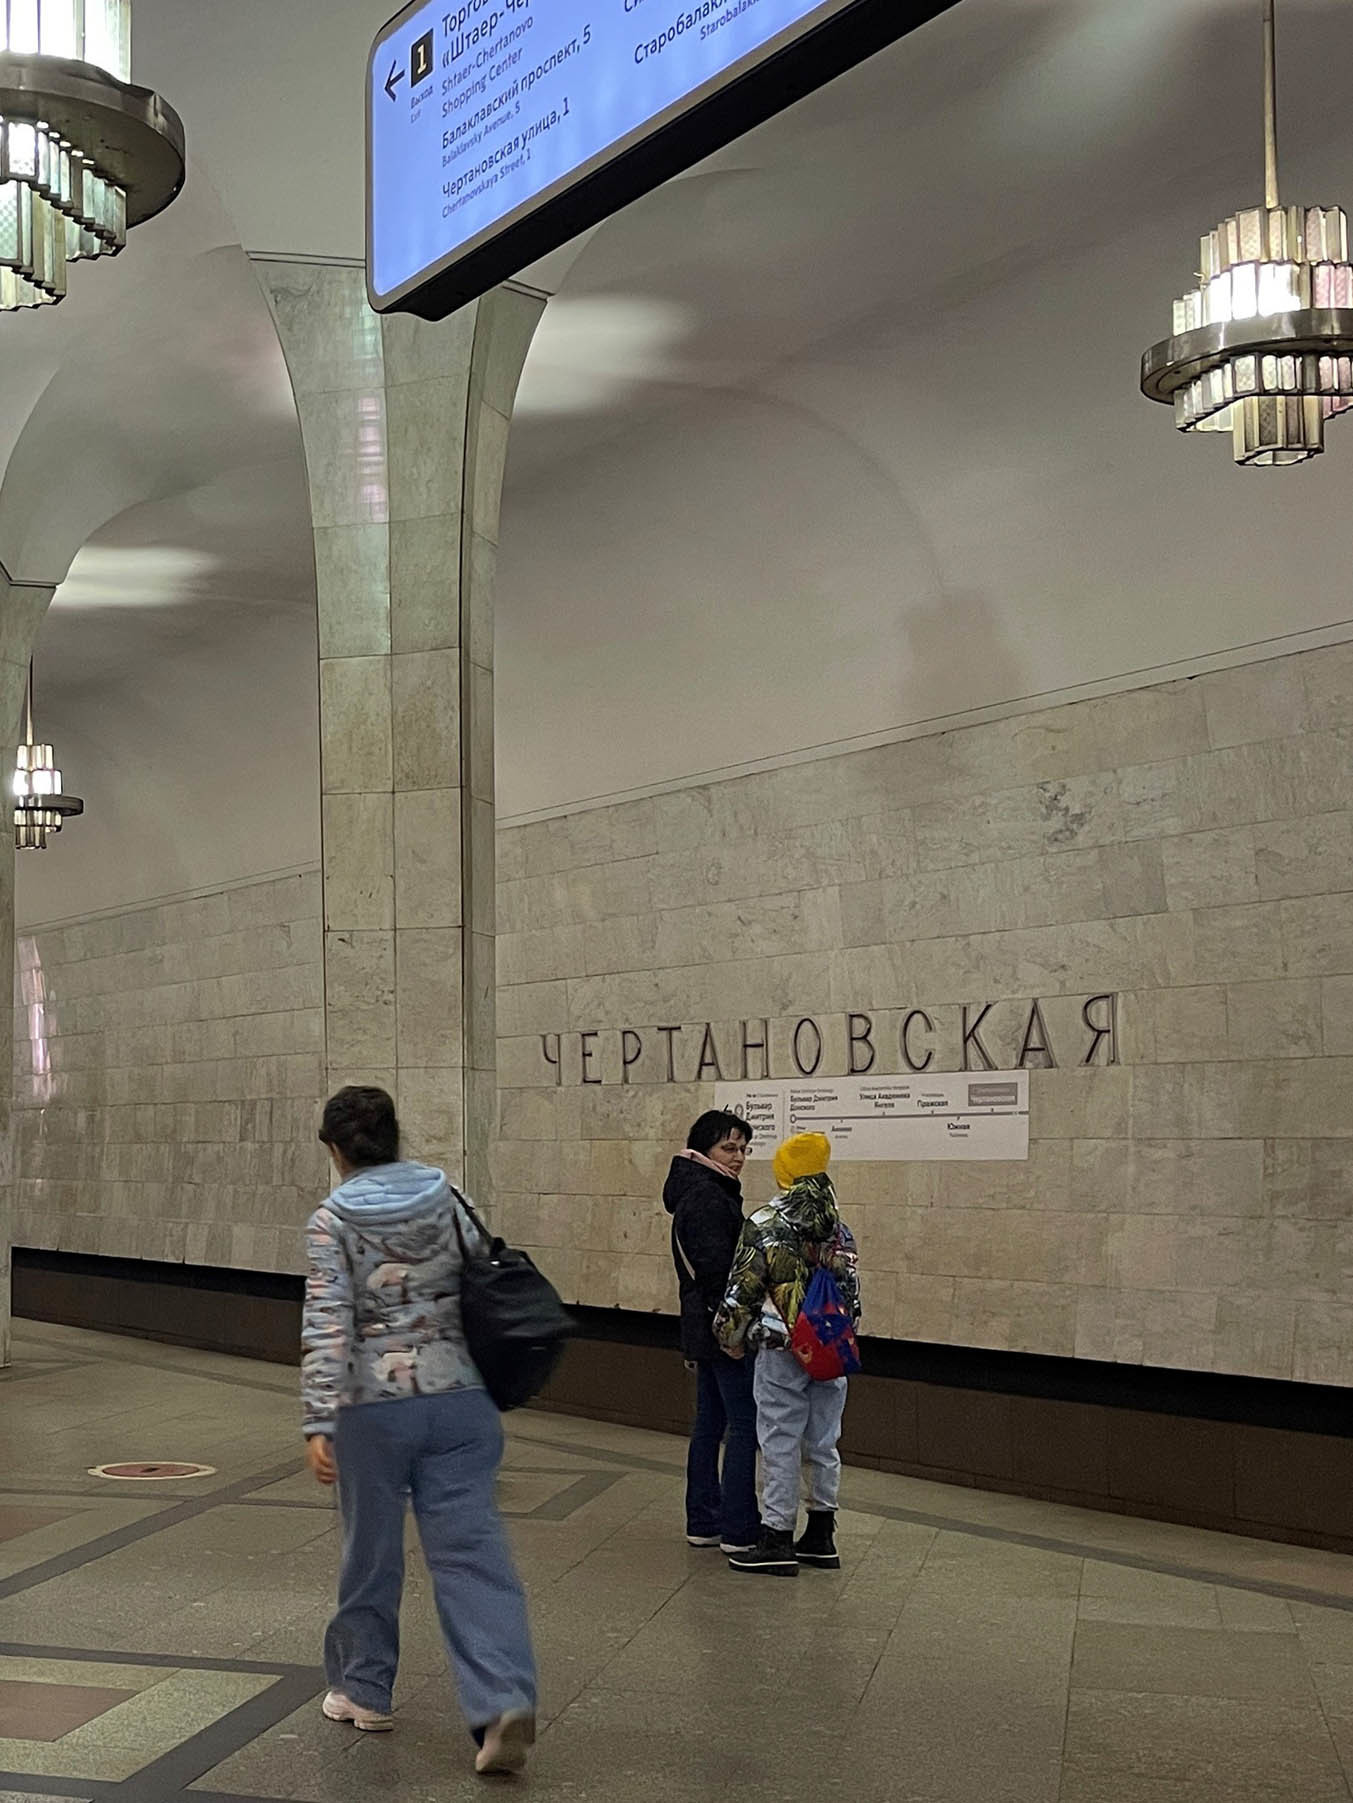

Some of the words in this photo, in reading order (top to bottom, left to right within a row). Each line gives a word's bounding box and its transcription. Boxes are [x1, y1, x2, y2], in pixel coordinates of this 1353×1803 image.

[417, 44, 427, 75] 1
[442, 16, 533, 96] Shtaer-Chertanovo
[442, 73, 487, 118] Shopping
[488, 47, 523, 82] Center
[442, 80, 519, 149] Балаклавский
[521, 37, 581, 92] проспект,
[583, 24, 592, 45] 5
[442, 135, 520, 198] Чертановская
[521, 108, 561, 151] улица,
[563, 97, 570, 116] 1
[515, 101, 521, 115] 5
[542, 993, 1120, 1085] ЧЕРТАНОВСКАЯ
